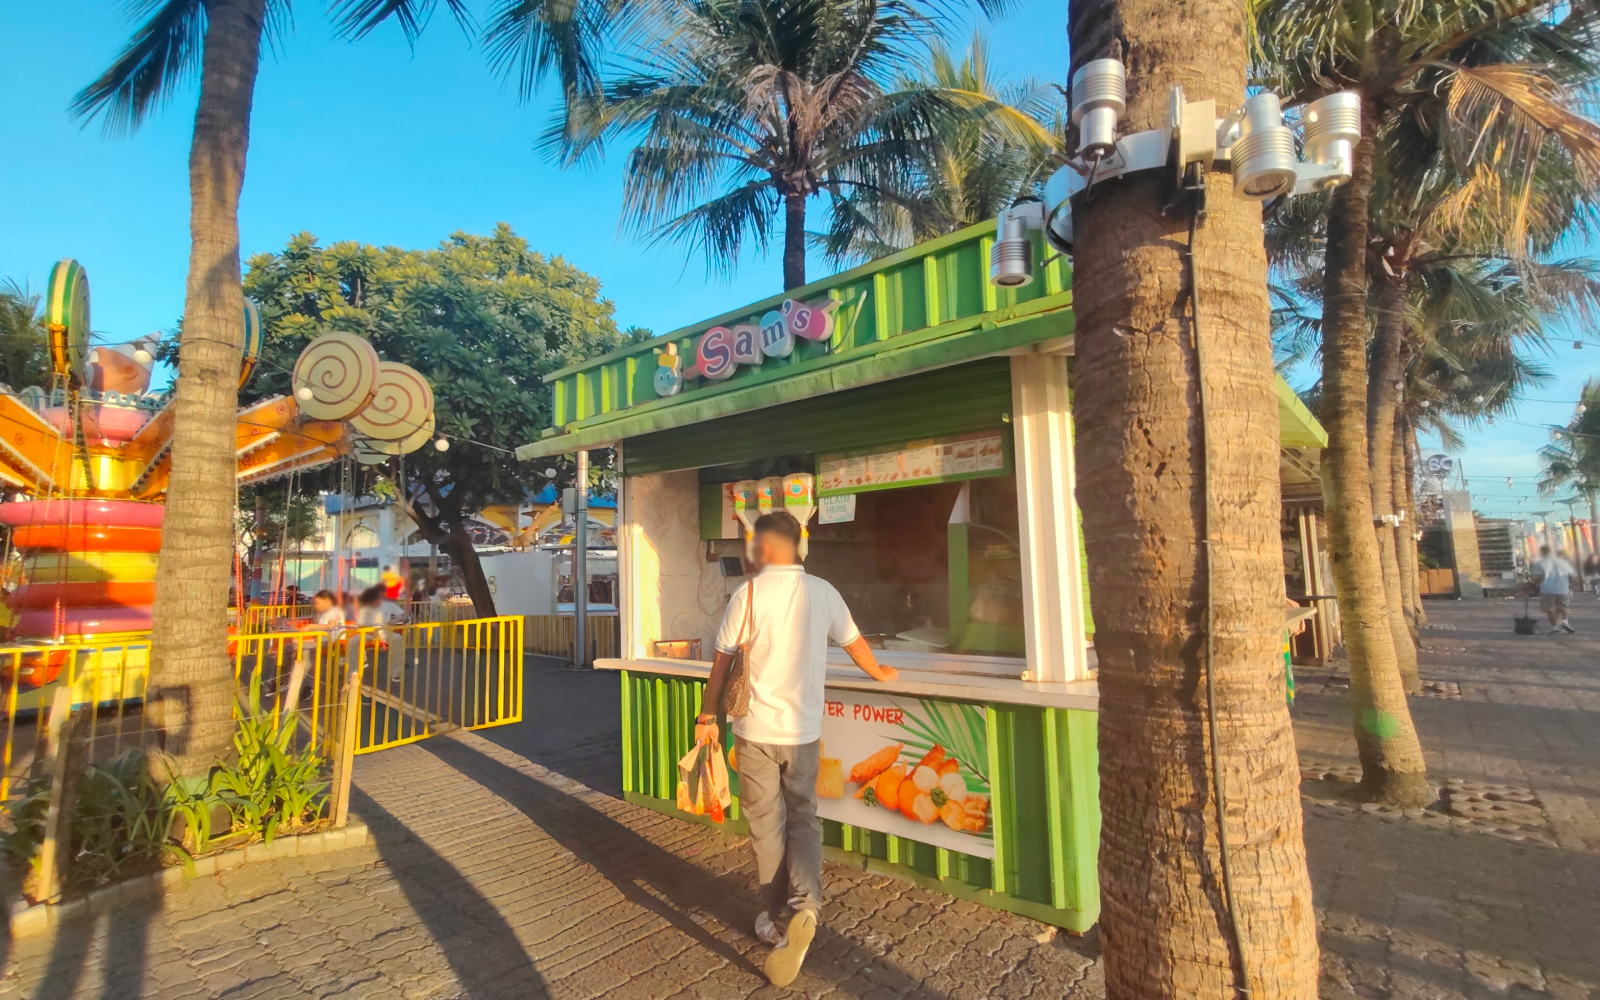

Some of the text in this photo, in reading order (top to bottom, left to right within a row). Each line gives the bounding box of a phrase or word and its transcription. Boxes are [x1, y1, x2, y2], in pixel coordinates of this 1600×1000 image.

[701, 299, 811, 375] Sam's
[823, 495, 850, 505] CLAIM
[825, 505, 847, 513] HERE
[853, 704, 904, 725] POWER
